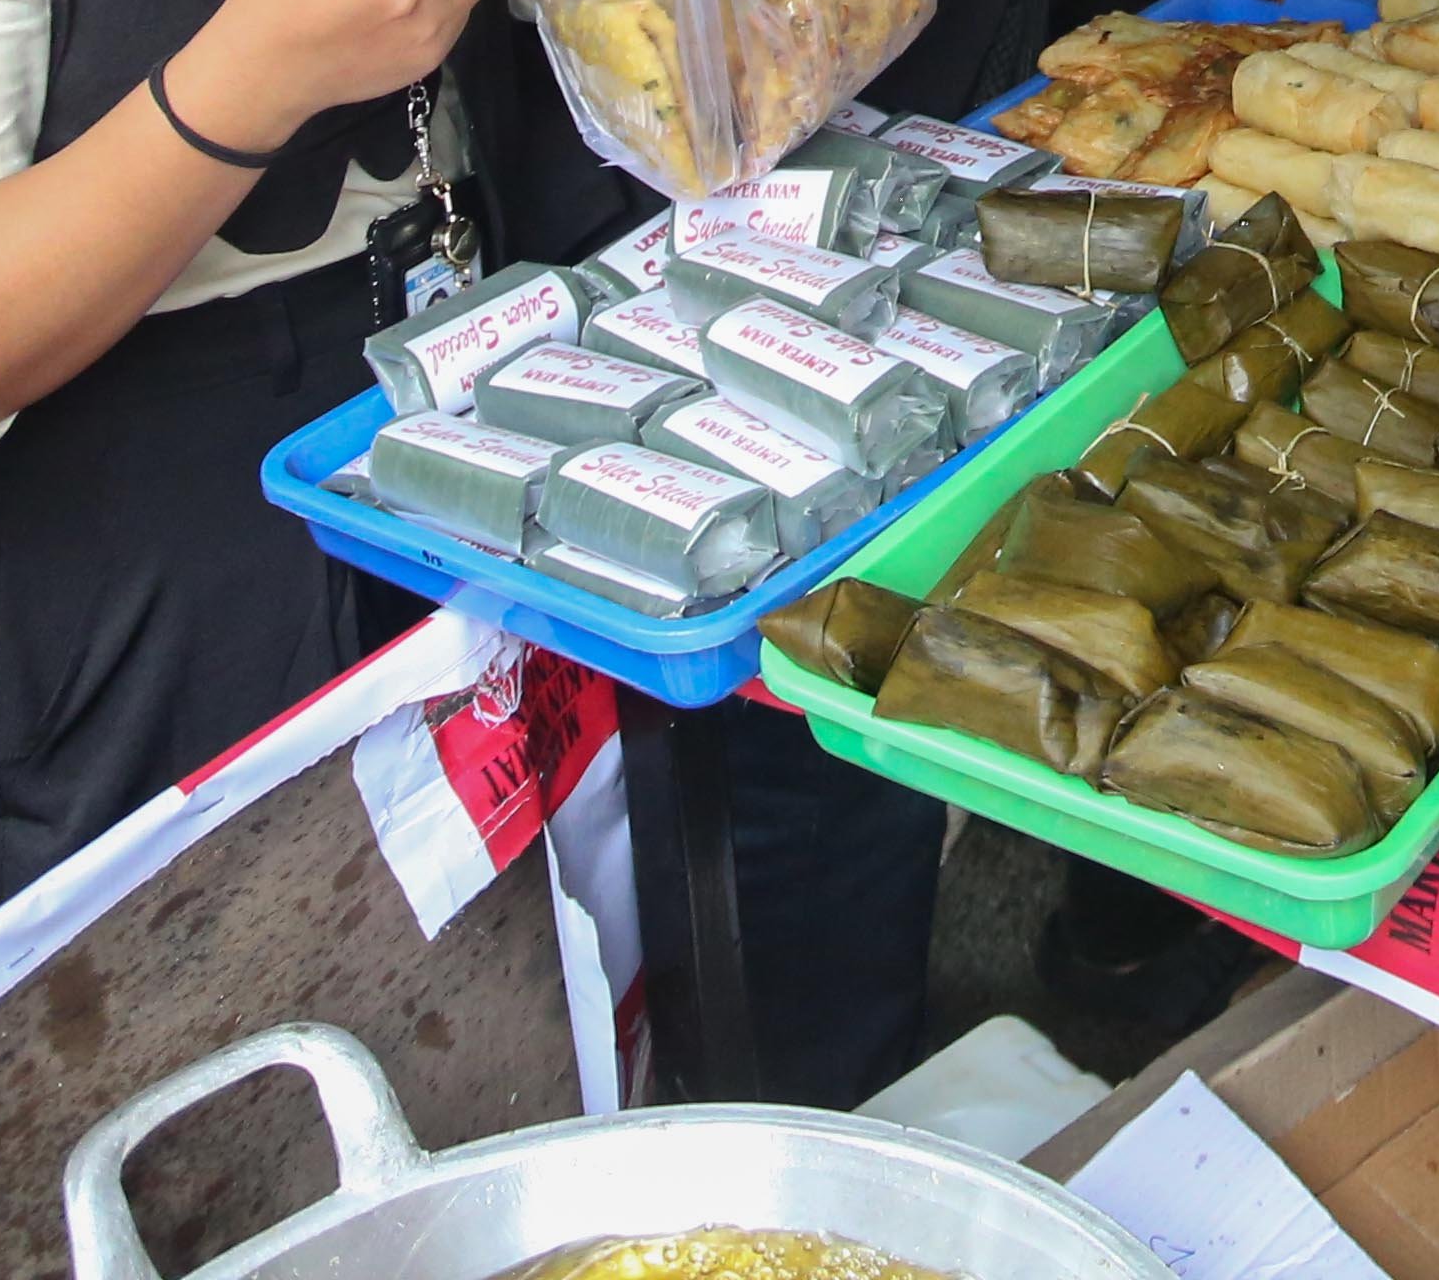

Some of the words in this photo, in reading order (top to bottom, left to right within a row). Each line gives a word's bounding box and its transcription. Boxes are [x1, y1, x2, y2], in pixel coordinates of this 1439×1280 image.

[927, 147, 978, 168] LEMPER
[762, 182, 801, 199] AYAM
[701, 242, 762, 266] Super
[759, 258, 842, 291] Special
[502, 285, 560, 326] Super
[616, 306, 673, 334] Super
[425, 315, 499, 376] Special
[737, 324, 779, 349] AYAM
[823, 332, 891, 366] Super
[909, 336, 964, 363] LEMPER
[776, 337, 840, 378] LEMPER
[519, 368, 561, 384] AYAM
[559, 376, 622, 395] LEMPER
[694, 416, 741, 441] AYAM
[730, 434, 792, 469] LEMPER
[580, 453, 642, 484] Super
[634, 474, 723, 512] Special
